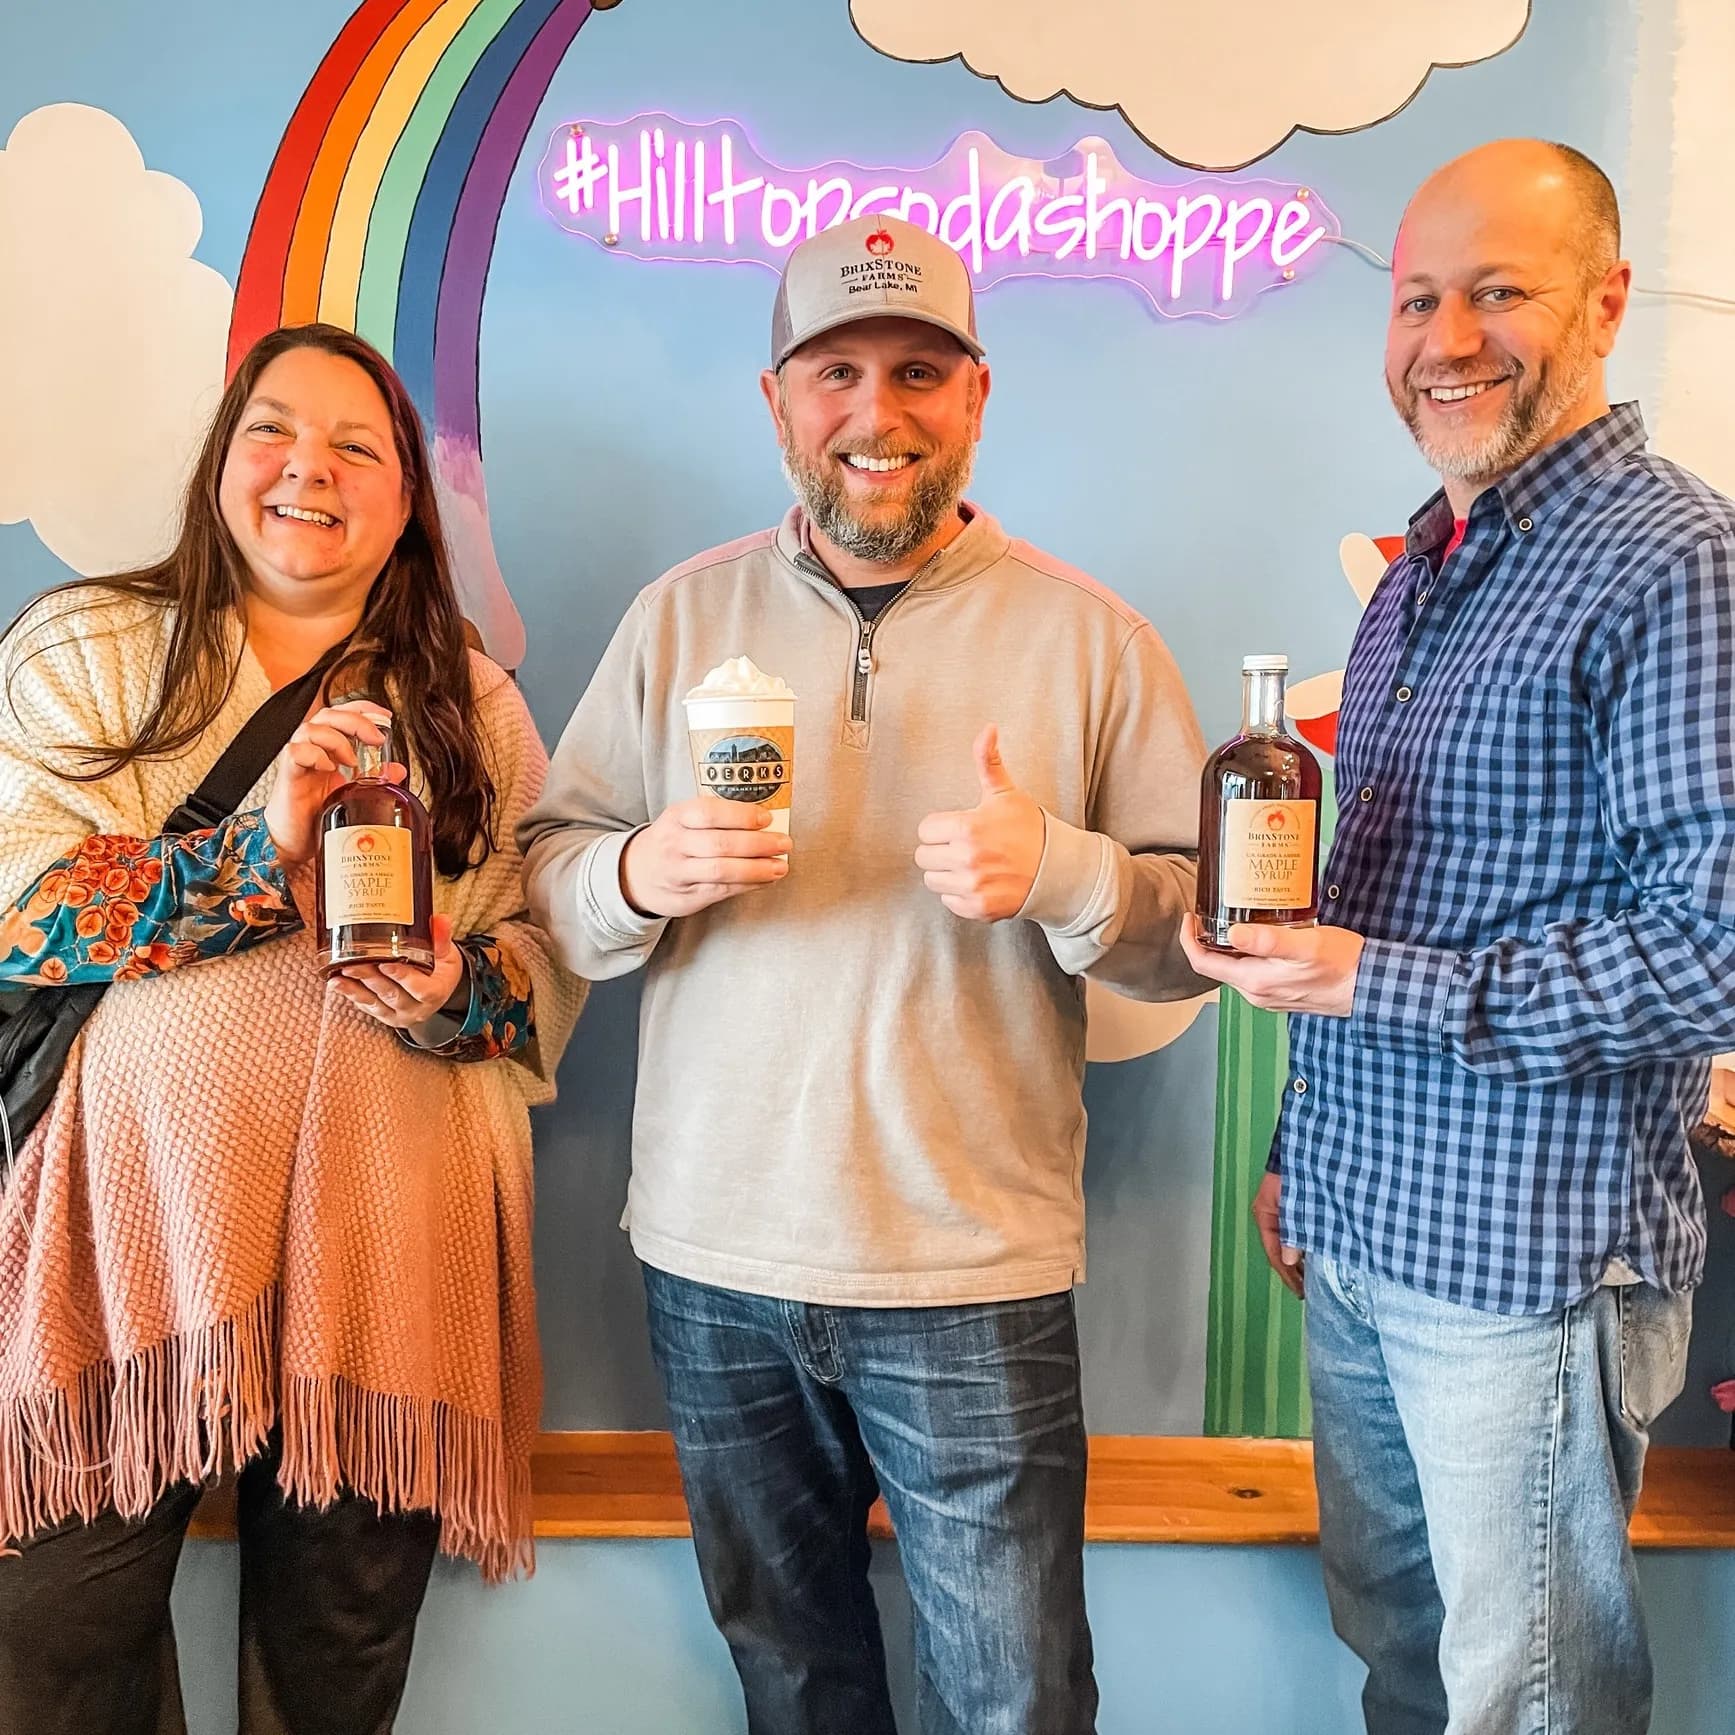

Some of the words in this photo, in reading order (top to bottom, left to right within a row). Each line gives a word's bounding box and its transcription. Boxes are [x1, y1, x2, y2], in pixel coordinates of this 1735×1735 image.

[861, 272, 904, 281] FARMS
[848, 283, 872, 294] Bear
[874, 281, 903, 291] Lake,
[905, 283, 918, 293] MI
[708, 764, 783, 780] PERKS
[1249, 859, 1298, 871] MAPLE
[1254, 871, 1292, 881] SYRUP
[344, 877, 392, 889] MAPLE
[348, 888, 386, 897] SYRUP
